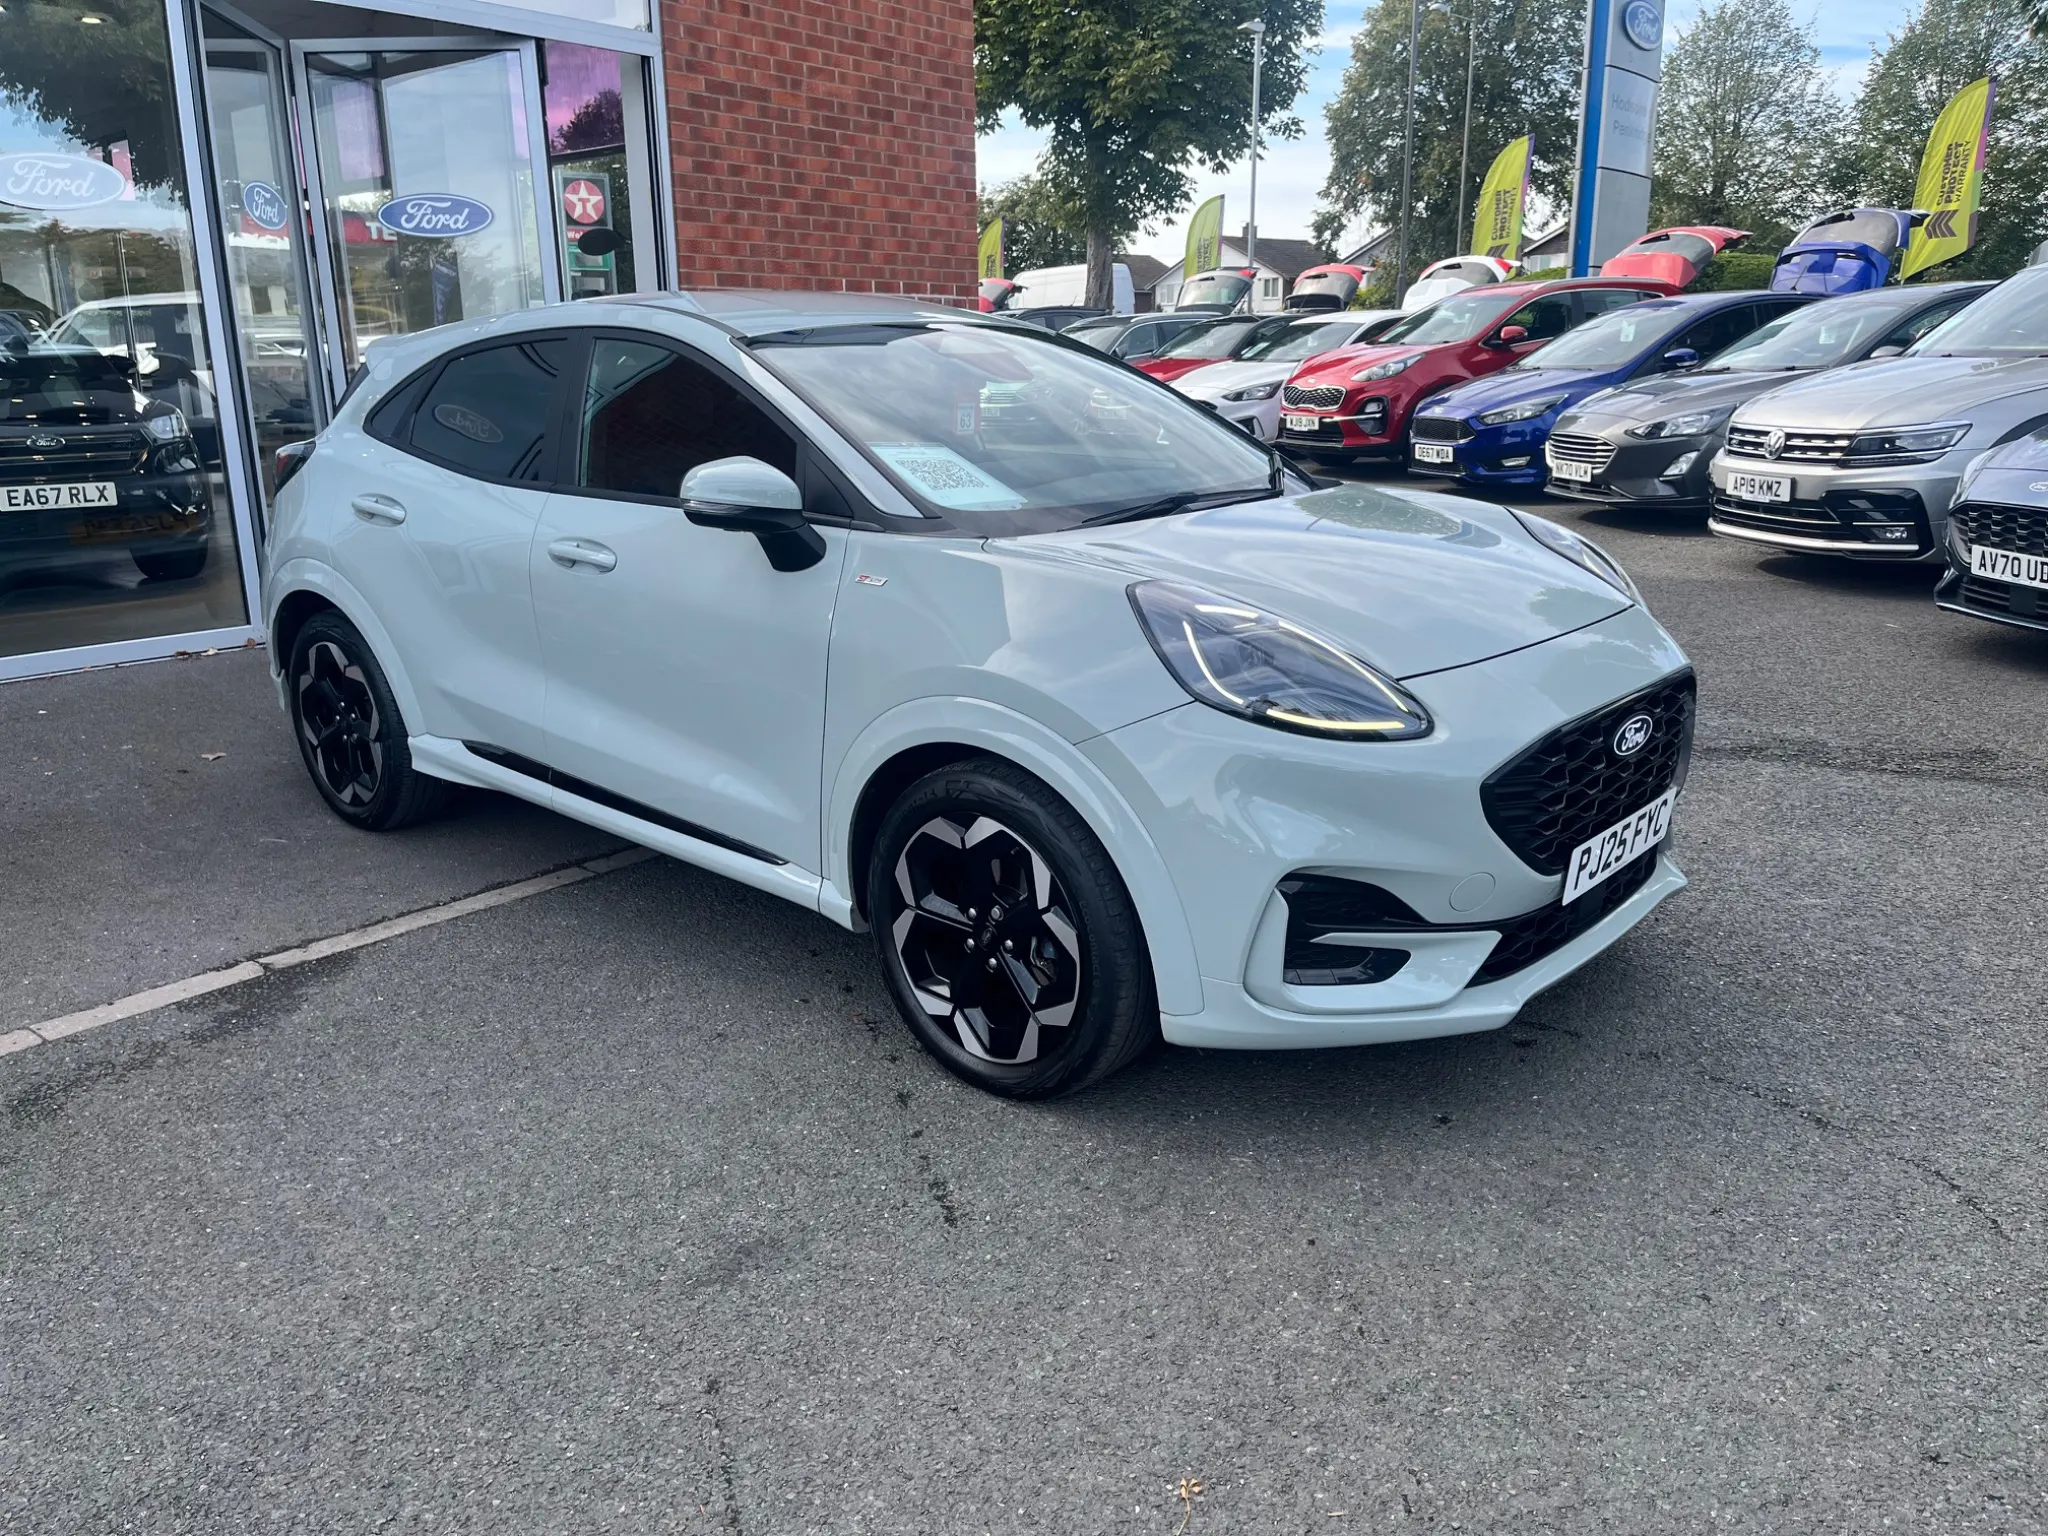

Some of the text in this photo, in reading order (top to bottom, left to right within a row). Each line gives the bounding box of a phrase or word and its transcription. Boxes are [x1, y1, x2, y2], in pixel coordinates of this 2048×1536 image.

[1634, 7, 1659, 41] Ford
[7, 159, 96, 198] Ford
[1936, 143, 1953, 206] CUSTOMER
[1944, 141, 1963, 204] PROTECT
[1954, 140, 1971, 203] WARRANTY
[252, 187, 280, 224] Ford
[400, 199, 470, 230] Ford
[960, 413, 971, 429] 63
[1418, 446, 1434, 459] OE67
[6, 485, 109, 507] EA67 RLX
[1733, 476, 1782, 497] AP19 KMZ
[1978, 550, 2020, 578] AV70
[1621, 721, 1648, 752] Ford
[1573, 797, 1668, 891] PJ25 FYC
